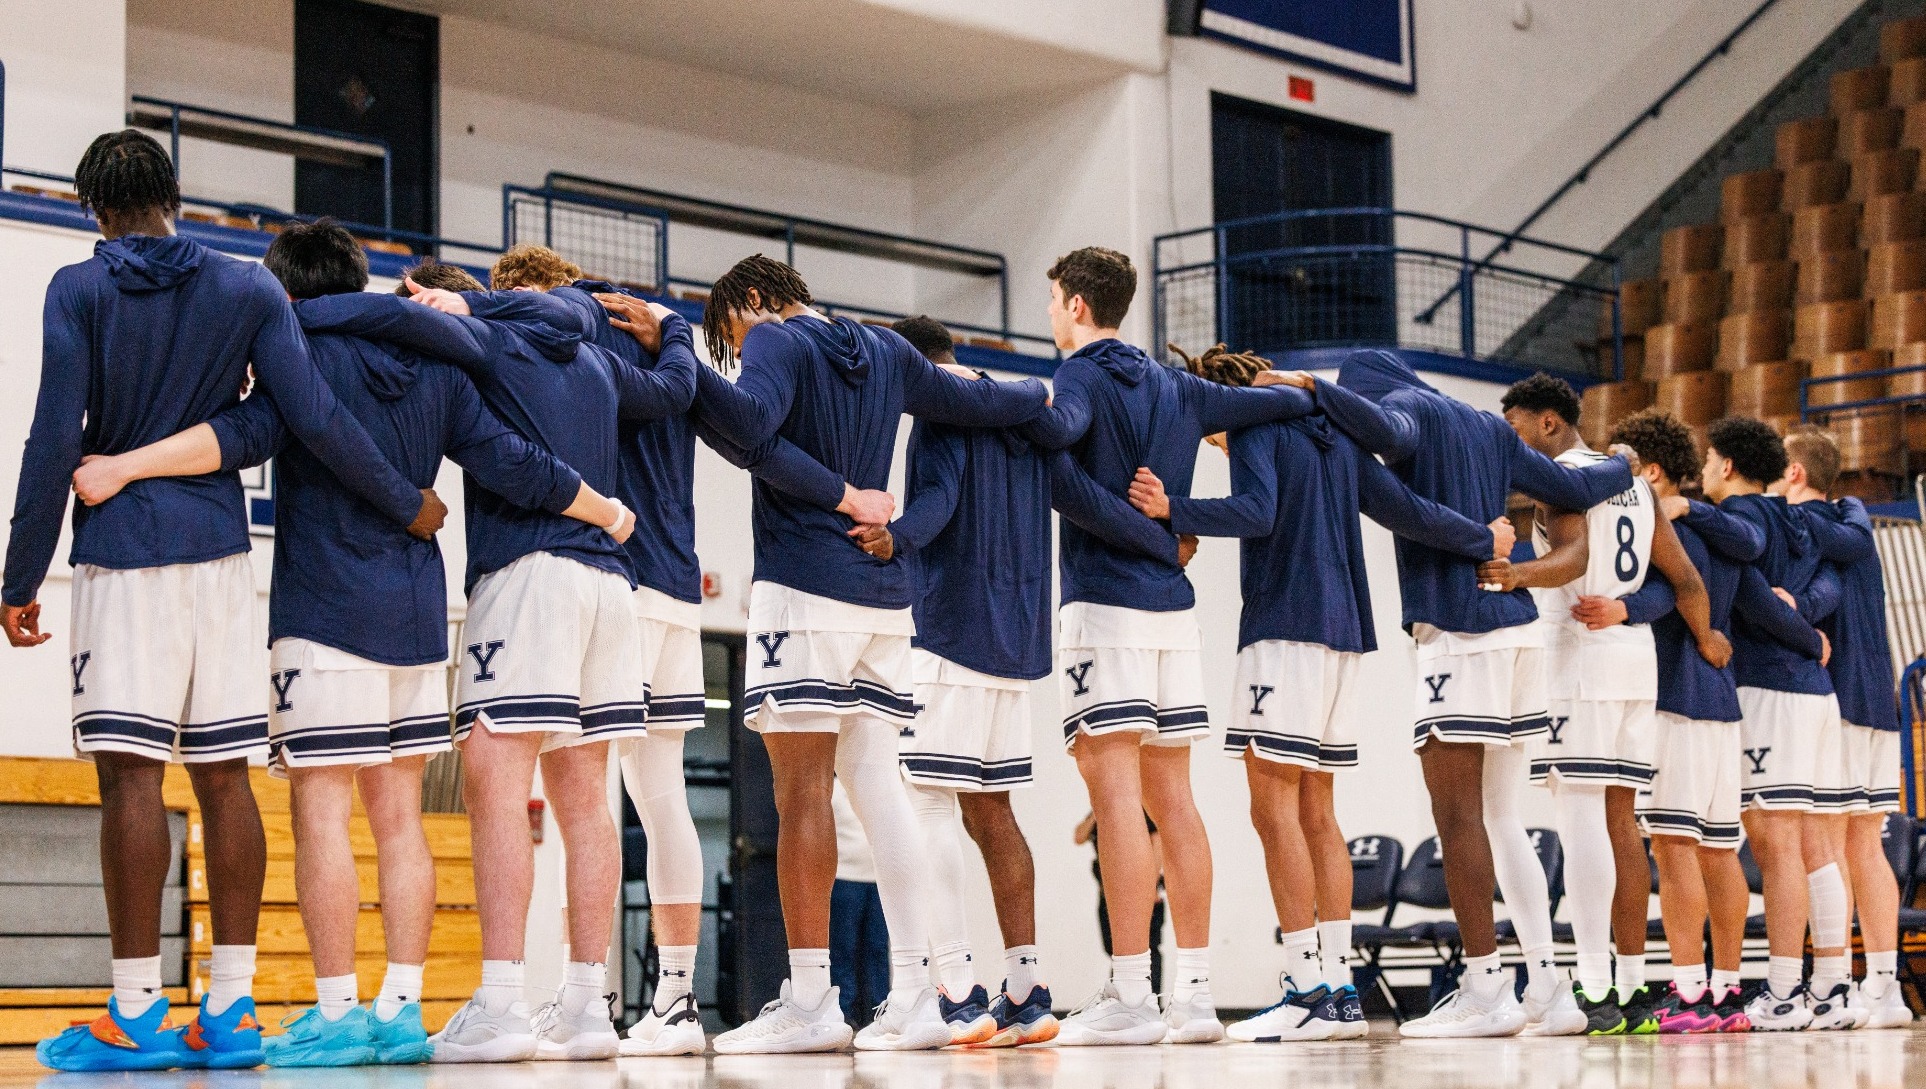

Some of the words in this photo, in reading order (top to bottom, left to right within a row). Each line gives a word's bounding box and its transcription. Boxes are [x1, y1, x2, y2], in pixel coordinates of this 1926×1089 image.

[1615, 515, 1639, 582] 8
[467, 639, 505, 683] Y
[756, 630, 790, 668] Y
[71, 650, 91, 697] Y
[271, 668, 301, 714] Y
[1065, 659, 1094, 697] Y
[1424, 673, 1452, 704] Y
[1249, 684, 1275, 716] Y
[1546, 716, 1569, 744] Y
[1743, 746, 1771, 775] Y
